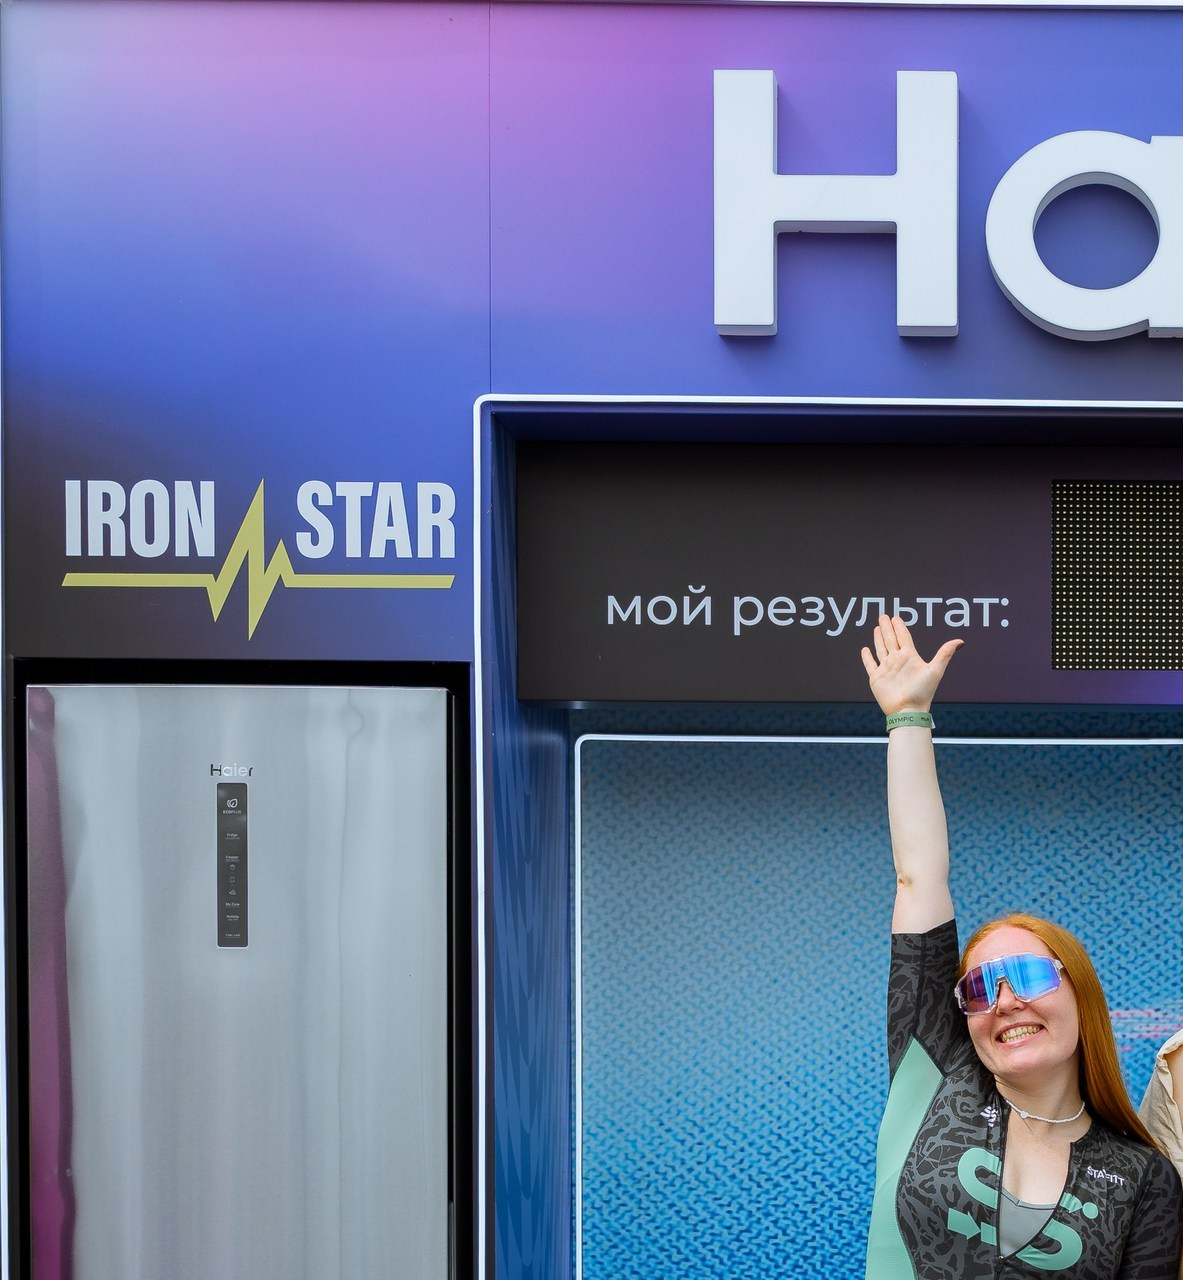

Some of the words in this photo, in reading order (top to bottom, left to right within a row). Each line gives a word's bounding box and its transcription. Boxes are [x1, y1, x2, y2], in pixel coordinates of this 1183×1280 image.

[65, 479, 215, 558] IRON
[295, 479, 457, 559] STAR
[606, 584, 713, 627] мой
[733, 594, 1010, 637] результат:
[210, 763, 254, 777] Haier
